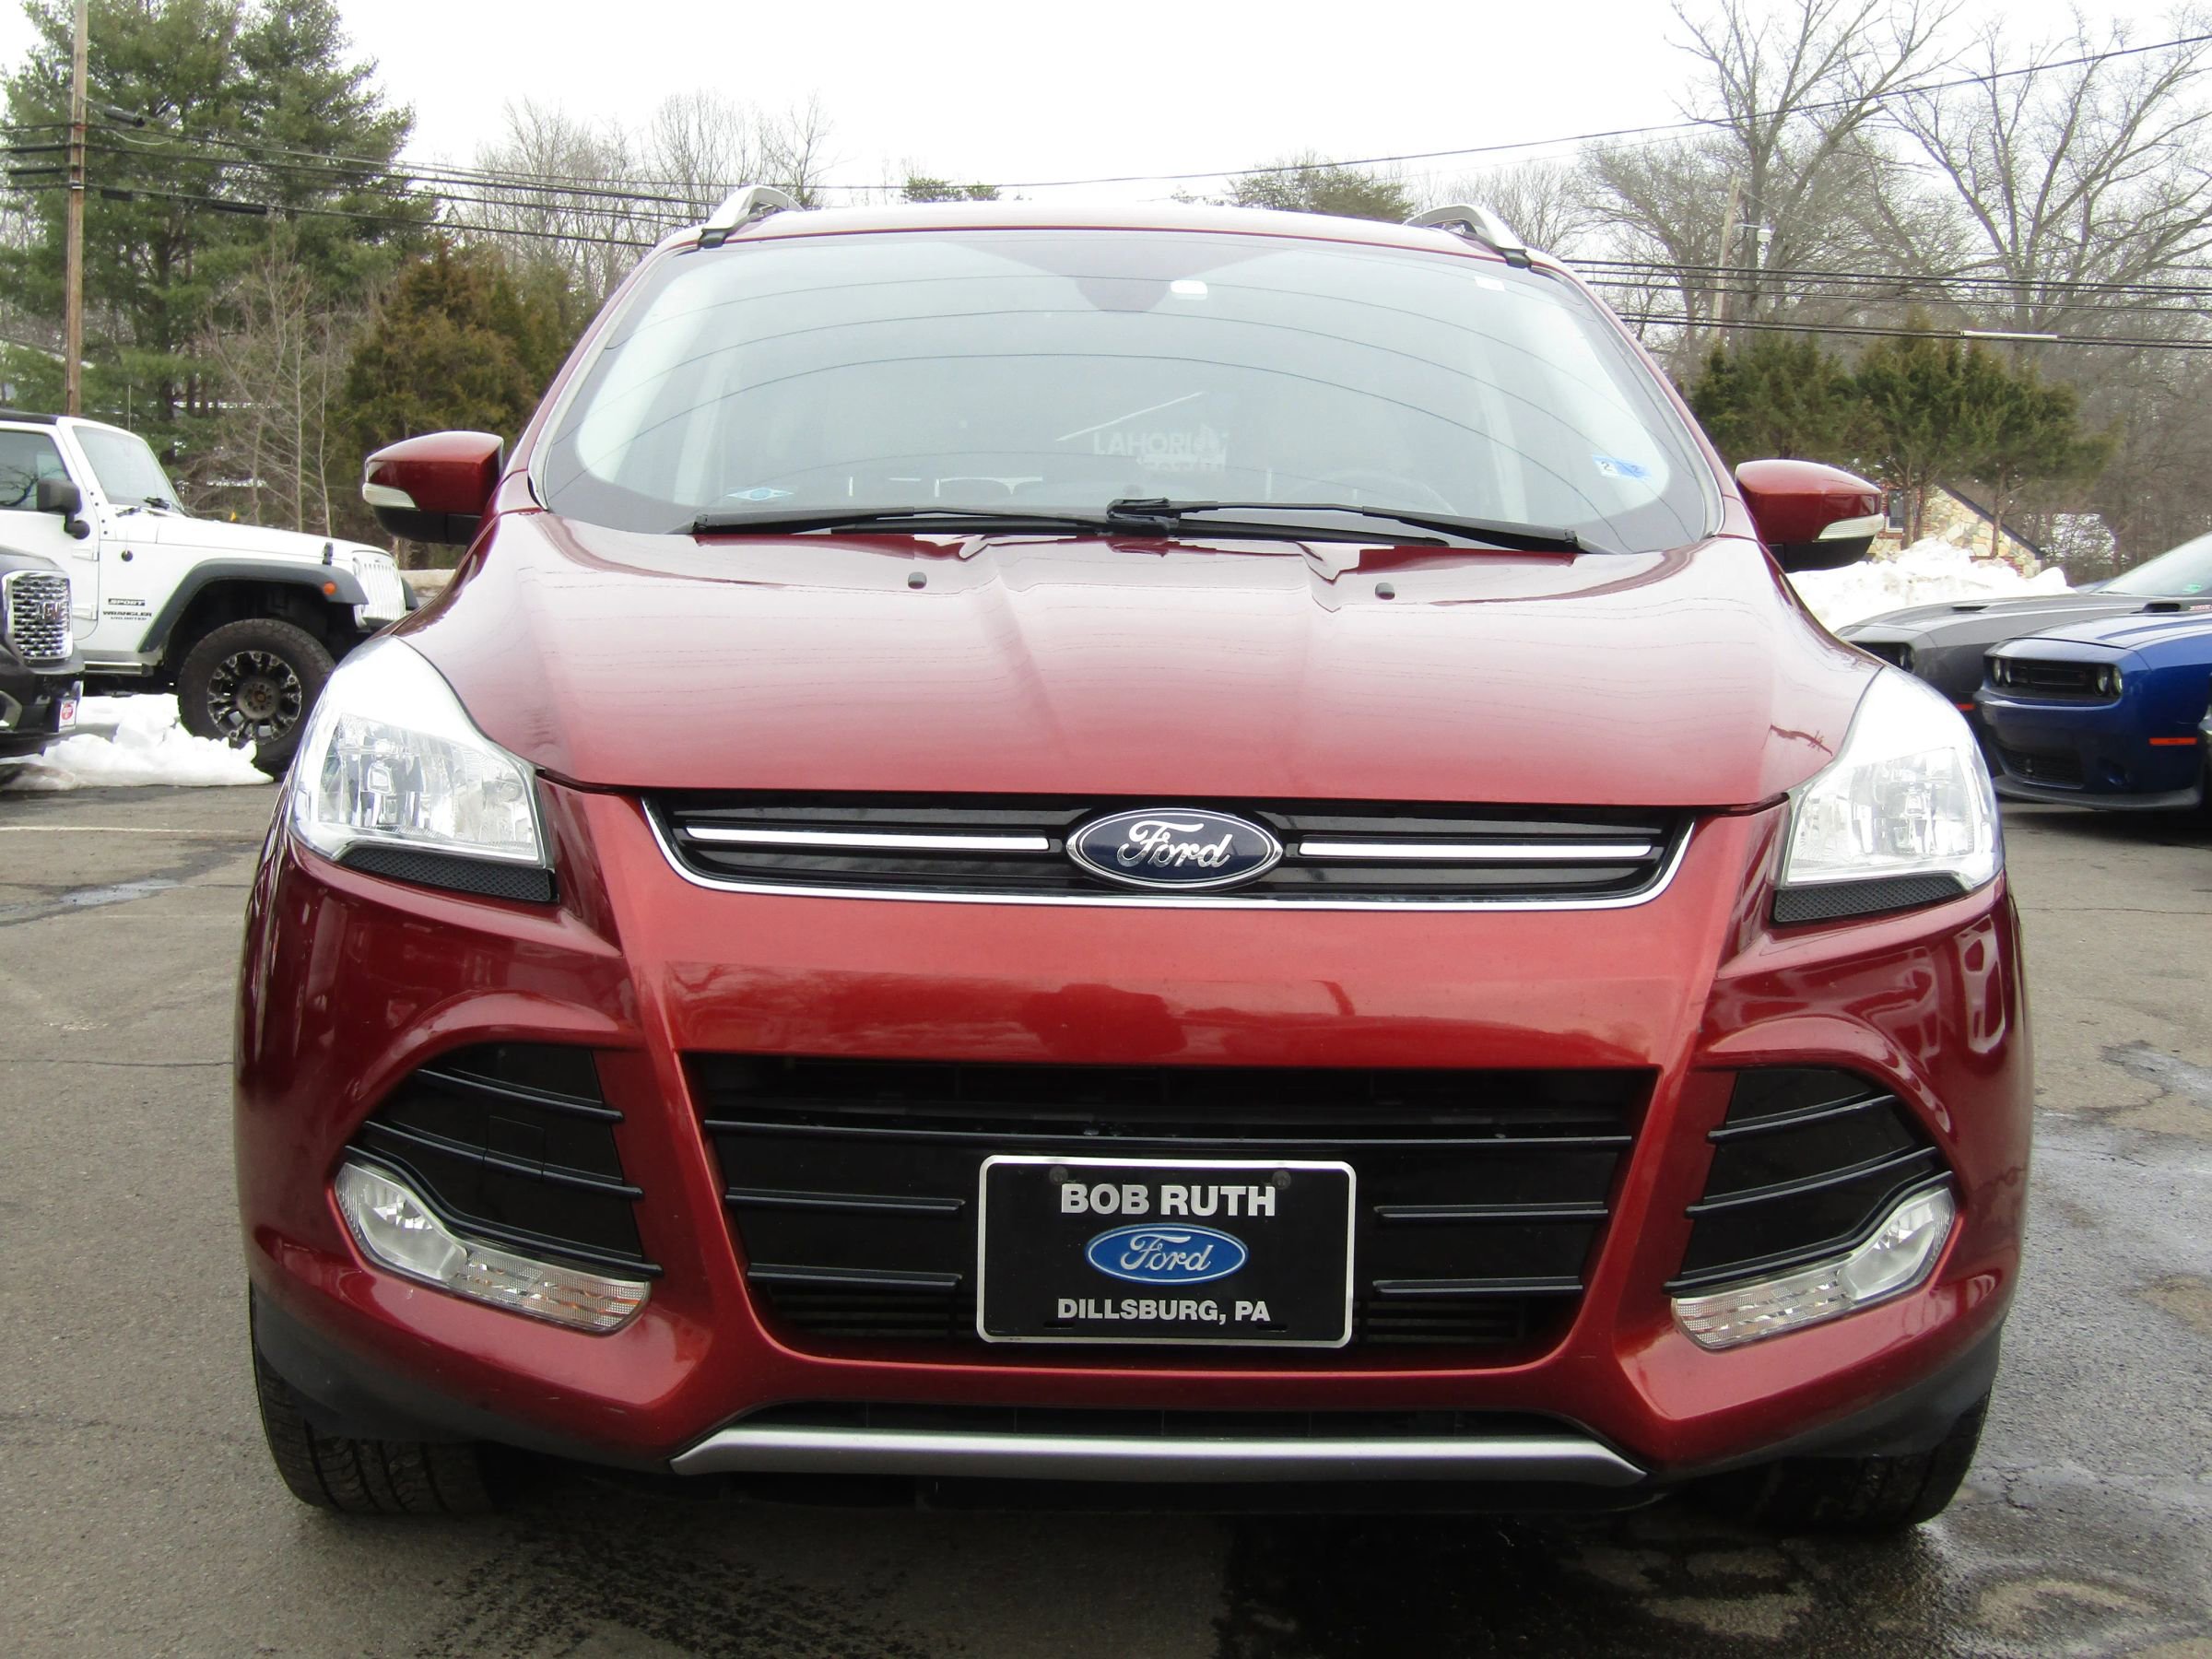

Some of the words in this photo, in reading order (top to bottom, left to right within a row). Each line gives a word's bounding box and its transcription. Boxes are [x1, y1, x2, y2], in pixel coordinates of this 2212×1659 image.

[109, 598, 145, 606] SPORT
[1117, 820, 1233, 868] Ford
[1061, 1183, 1150, 1215] BOB
[1160, 1185, 1276, 1217] RUTH
[1120, 1234, 1214, 1272] Ford
[1057, 1298, 1227, 1325] DILLSBURG,
[1235, 1300, 1271, 1322] PA
